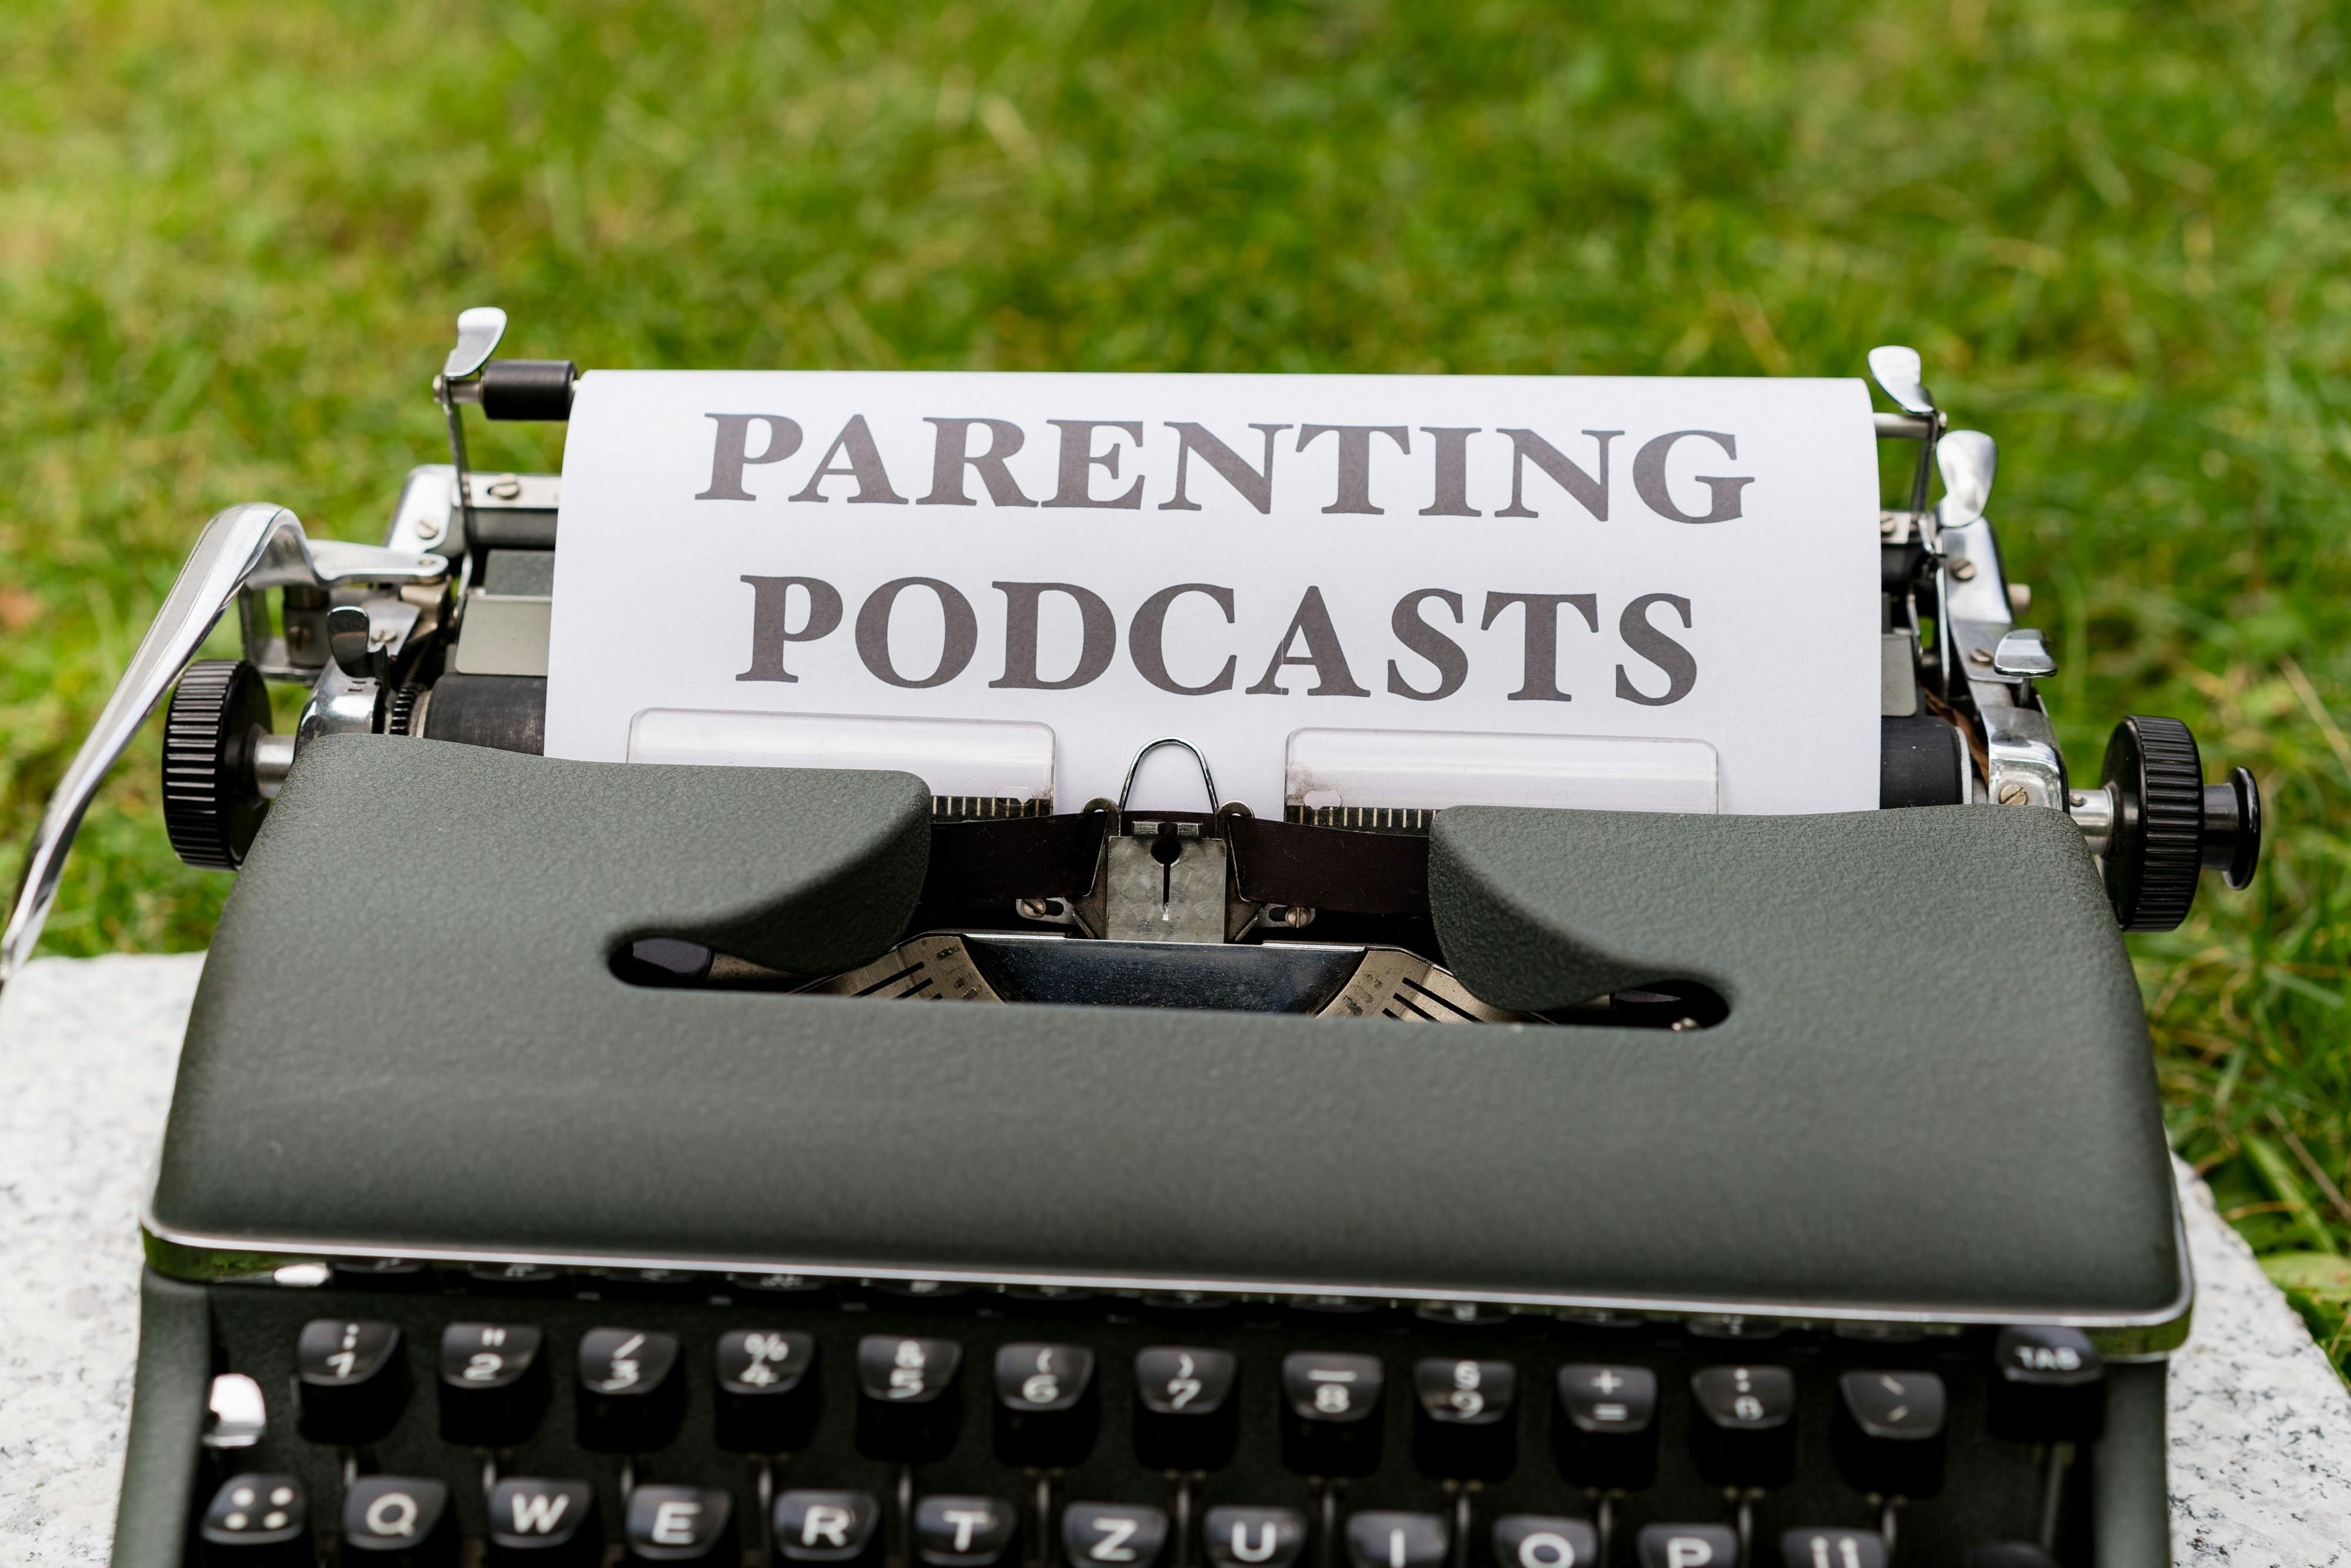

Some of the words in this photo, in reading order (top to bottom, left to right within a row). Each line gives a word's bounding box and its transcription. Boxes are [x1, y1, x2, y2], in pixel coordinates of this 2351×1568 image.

[694, 413, 1755, 524] PARENTING
[735, 574, 1697, 707] PODCASTS
[463, 1353, 503, 1381] 2
[603, 1359, 640, 1390] 3
[2015, 1346, 2082, 1370] TAB
[887, 1368, 925, 1399] 5
[1022, 1373, 1058, 1403] 6
[1166, 1378, 1202, 1410] 7
[1315, 1383, 1350, 1413] 8
[1450, 1389, 1484, 1419] 9
[366, 1493, 418, 1537] Q
[511, 1492, 570, 1533] W
[651, 1501, 701, 1544] E
[801, 1504, 851, 1546] R
[942, 1509, 989, 1552] T
[1090, 1517, 1139, 1561] Z
[1230, 1520, 1278, 1562] U
[1389, 1529, 1406, 1568] I
[1519, 1532, 1576, 1568] O
[1667, 1537, 1713, 1568] P
